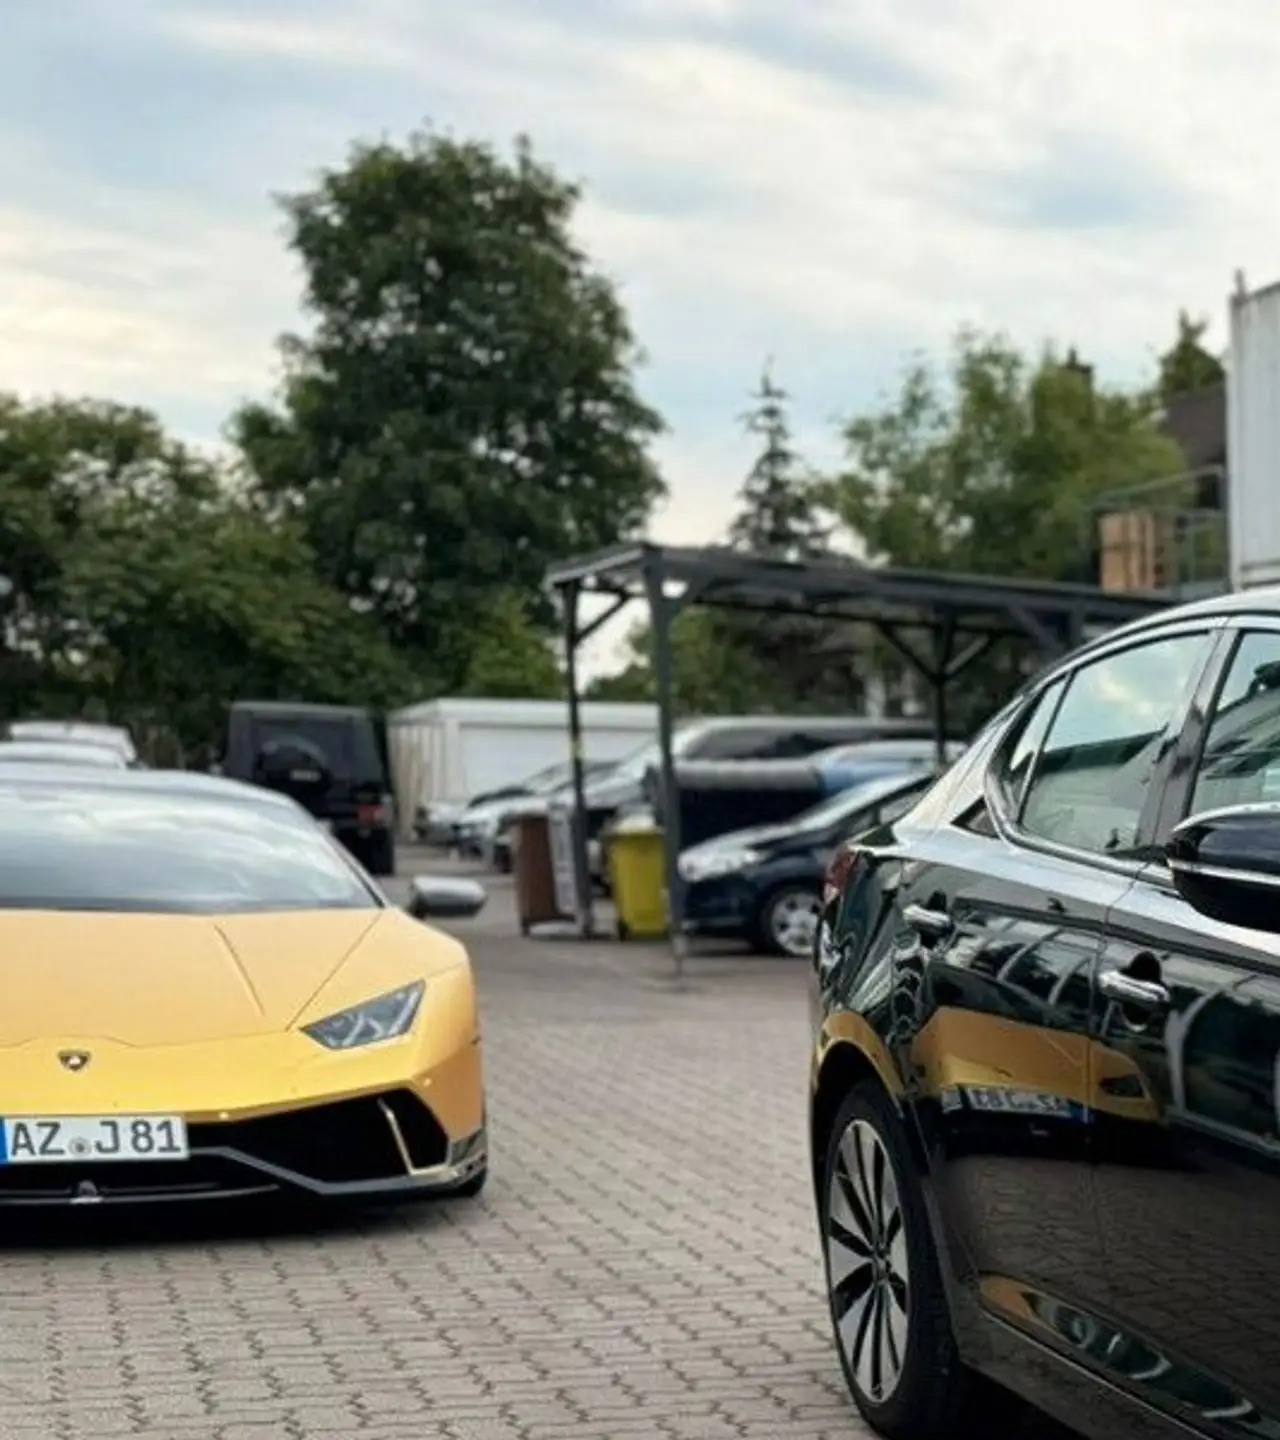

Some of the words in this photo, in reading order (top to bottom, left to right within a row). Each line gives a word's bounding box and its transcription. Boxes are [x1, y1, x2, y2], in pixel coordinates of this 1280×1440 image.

[11, 1121, 66, 1156] AZ
[94, 1120, 120, 1153] J
[131, 1119, 182, 1153] 81
